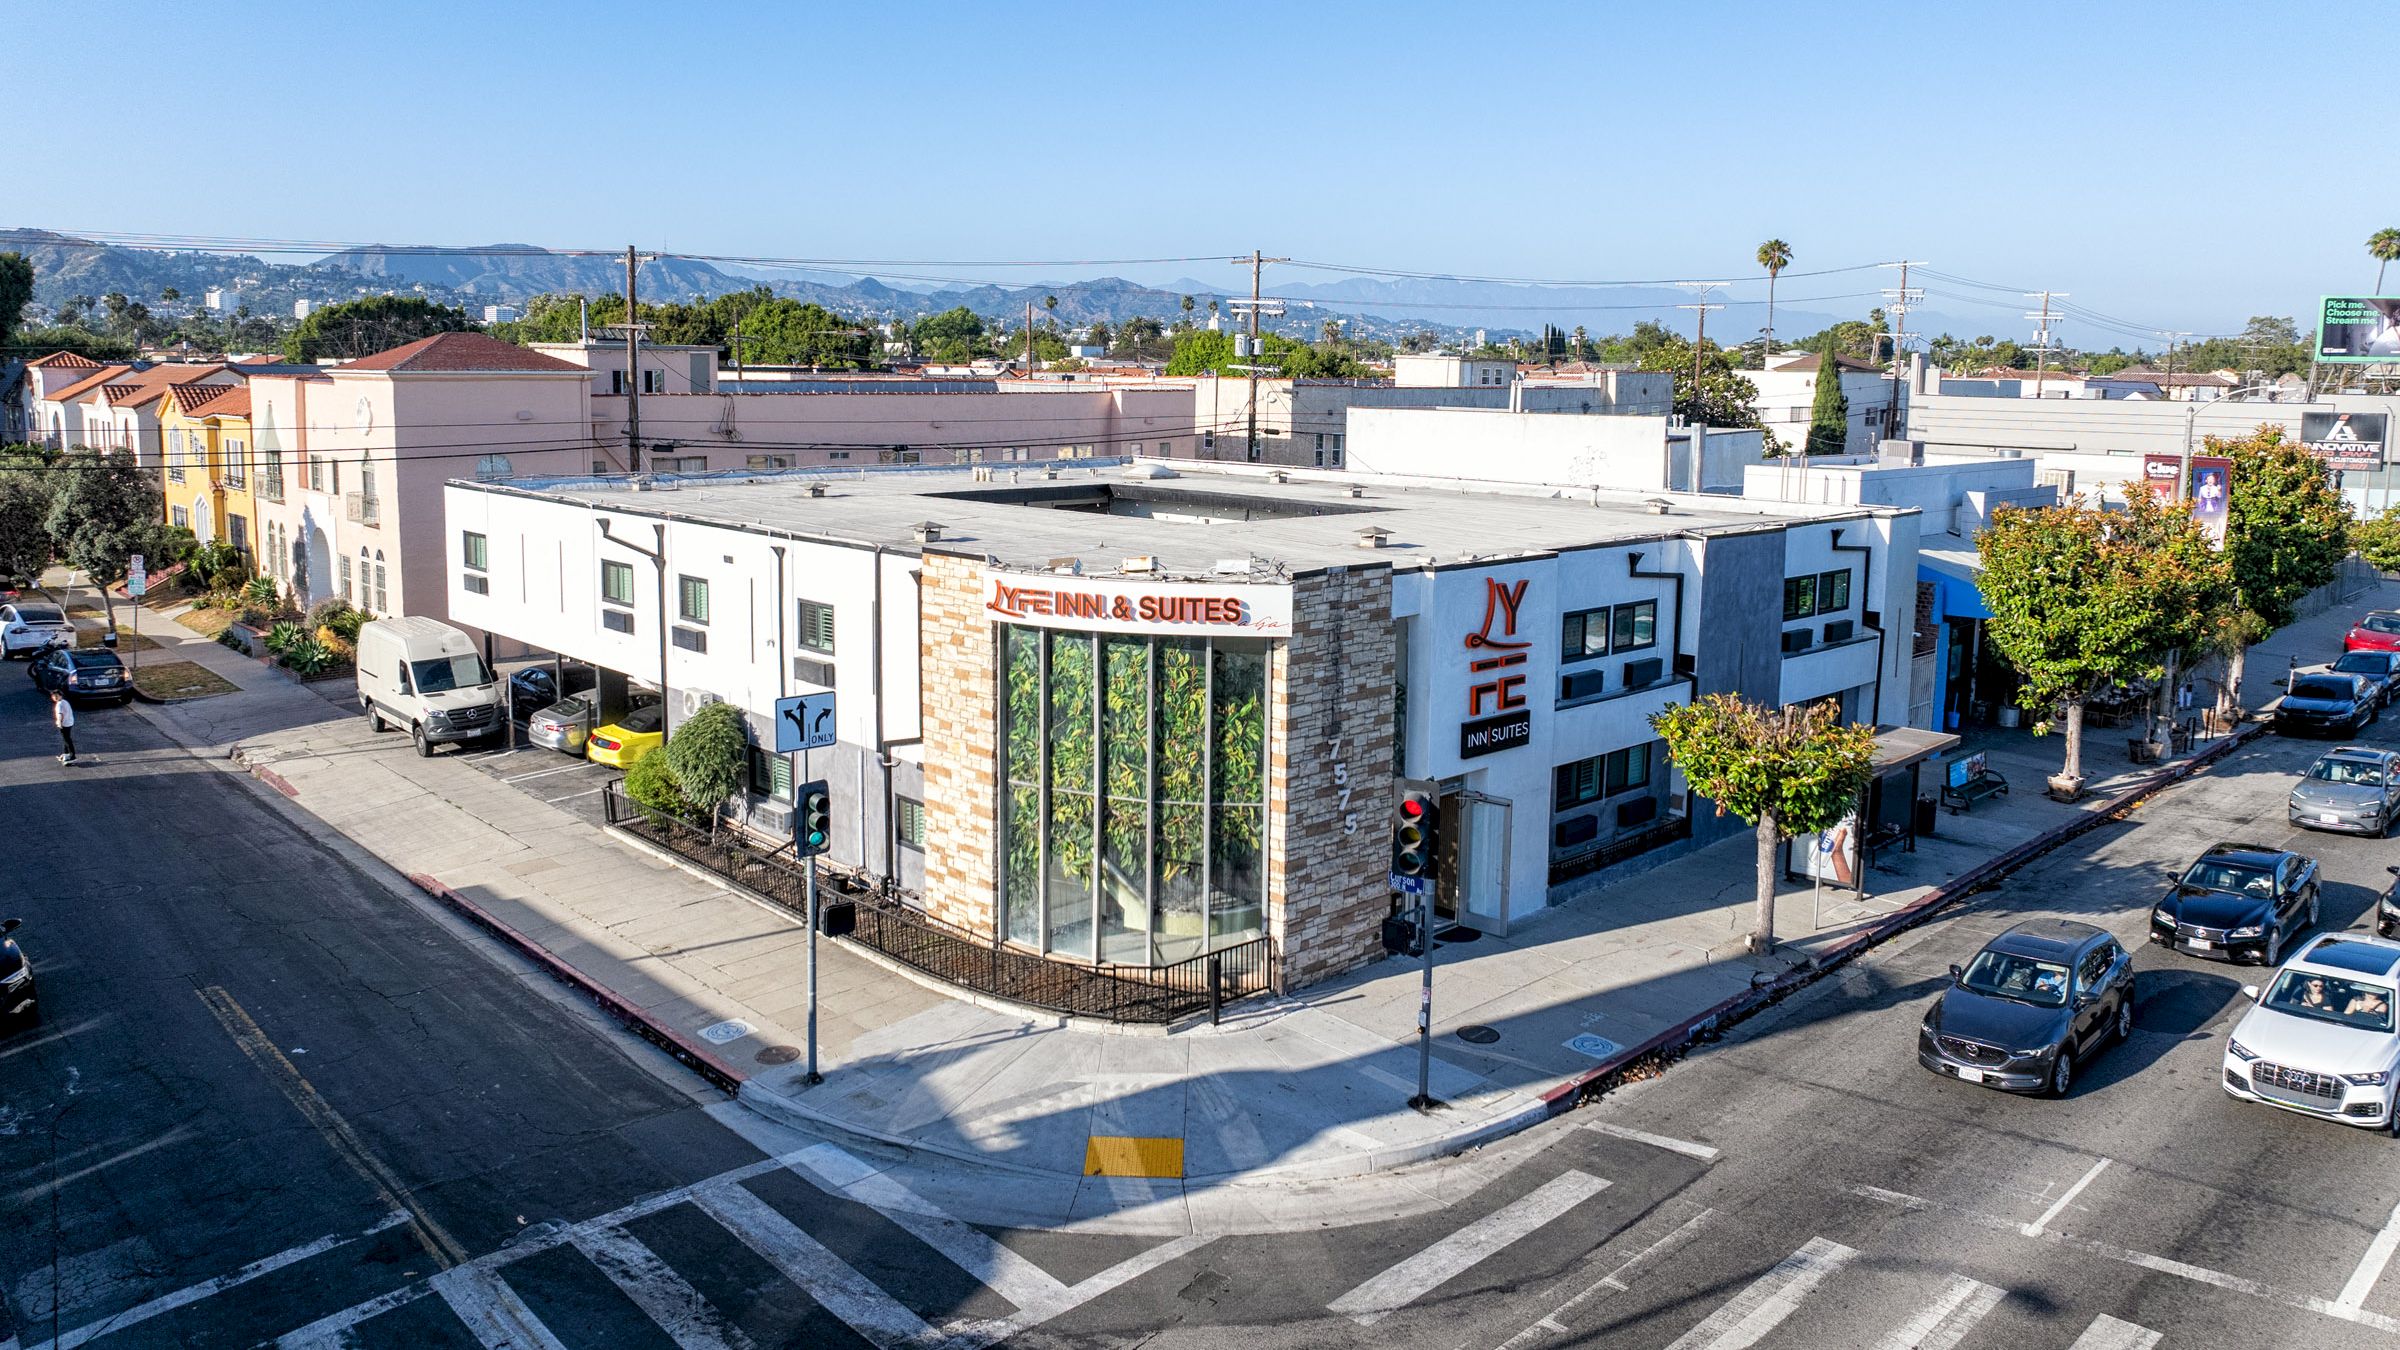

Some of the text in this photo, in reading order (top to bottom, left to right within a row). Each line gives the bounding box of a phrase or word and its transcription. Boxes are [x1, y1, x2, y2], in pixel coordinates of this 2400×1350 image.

[2327, 300, 2347, 308] Pick
[2326, 308, 2361, 316] Choose
[2325, 316, 2359, 324] Stream
[2146, 461, 2179, 475] Clue
[1112, 595, 1131, 621] &
[1139, 596, 1242, 623] SUITES
[811, 733, 833, 744] ONLY
[1467, 721, 1529, 748] INN SUITES
[1391, 872, 1415, 887] Curson
